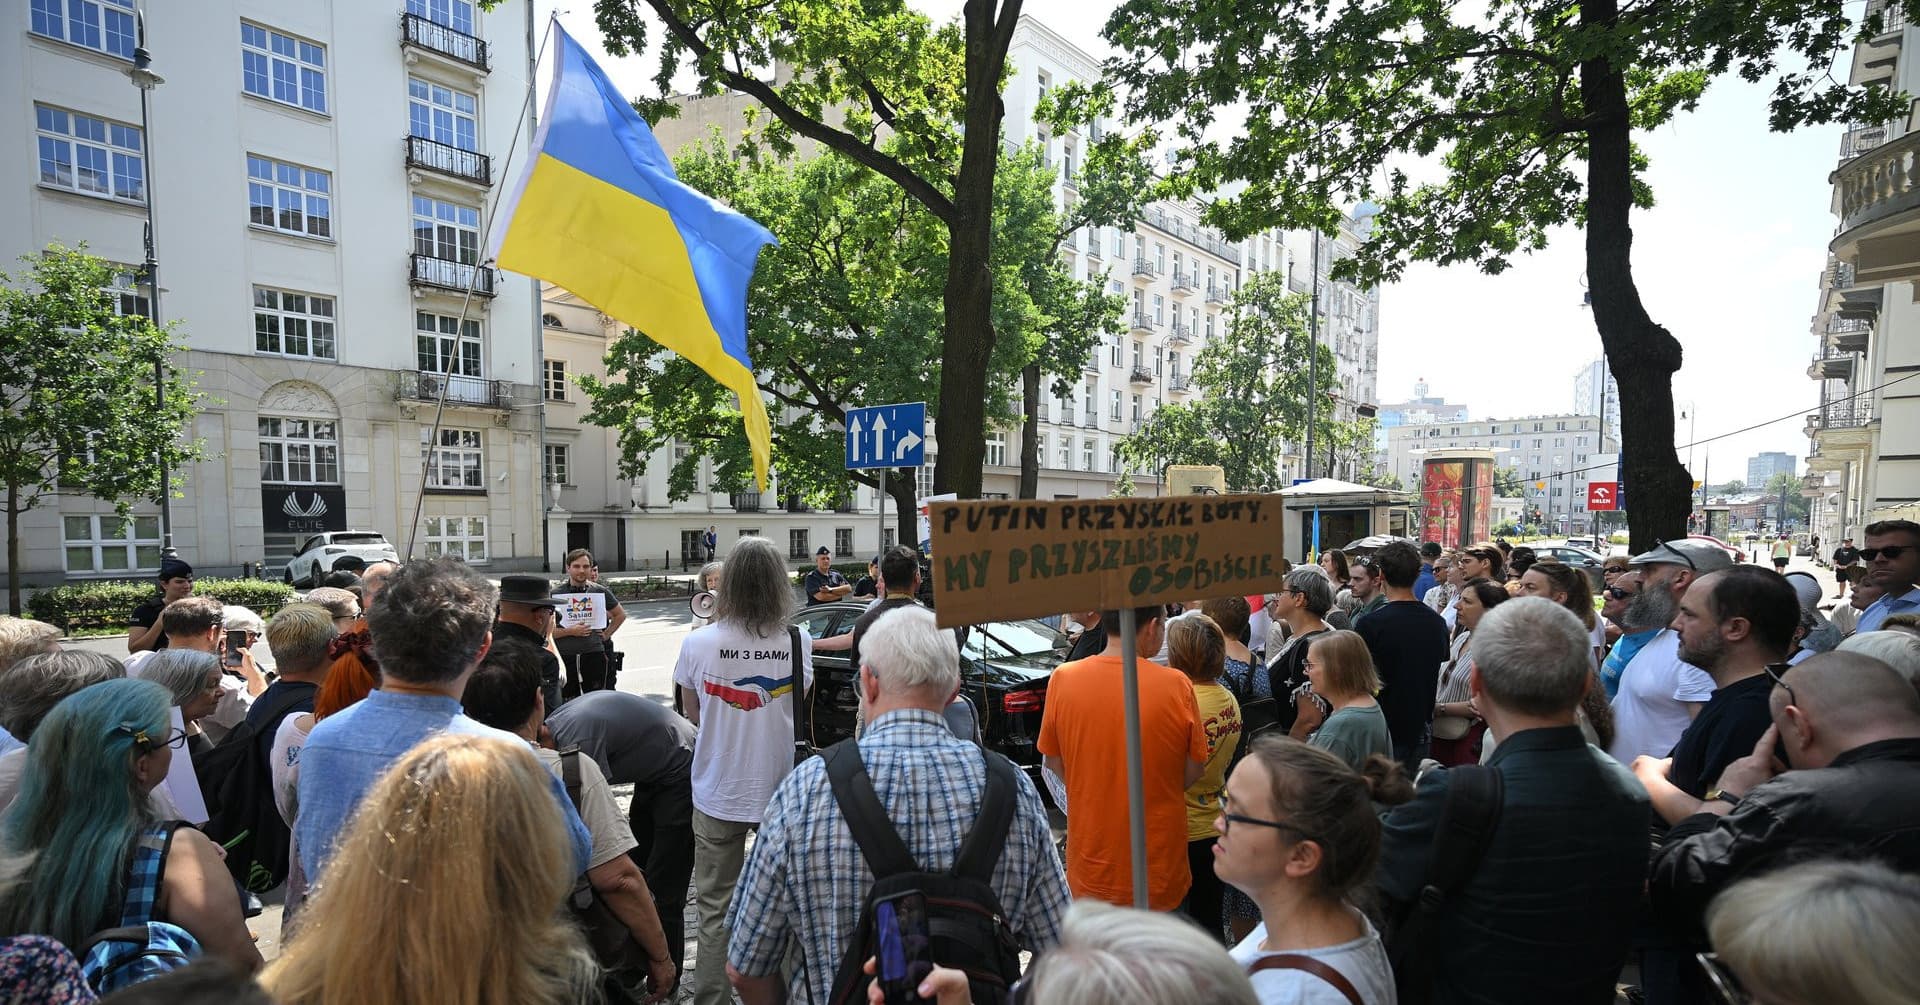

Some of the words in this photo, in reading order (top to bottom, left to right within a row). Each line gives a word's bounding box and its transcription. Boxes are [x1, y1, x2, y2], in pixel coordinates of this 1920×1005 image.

[288, 520, 325, 529] ELITE
[942, 505, 1047, 533] PUTIN
[945, 549, 992, 592] MY
[1008, 531, 1200, 584] PRZYSZLIŚMY
[720, 649, 739, 660] МИ
[754, 650, 790, 661] ВАМИ
